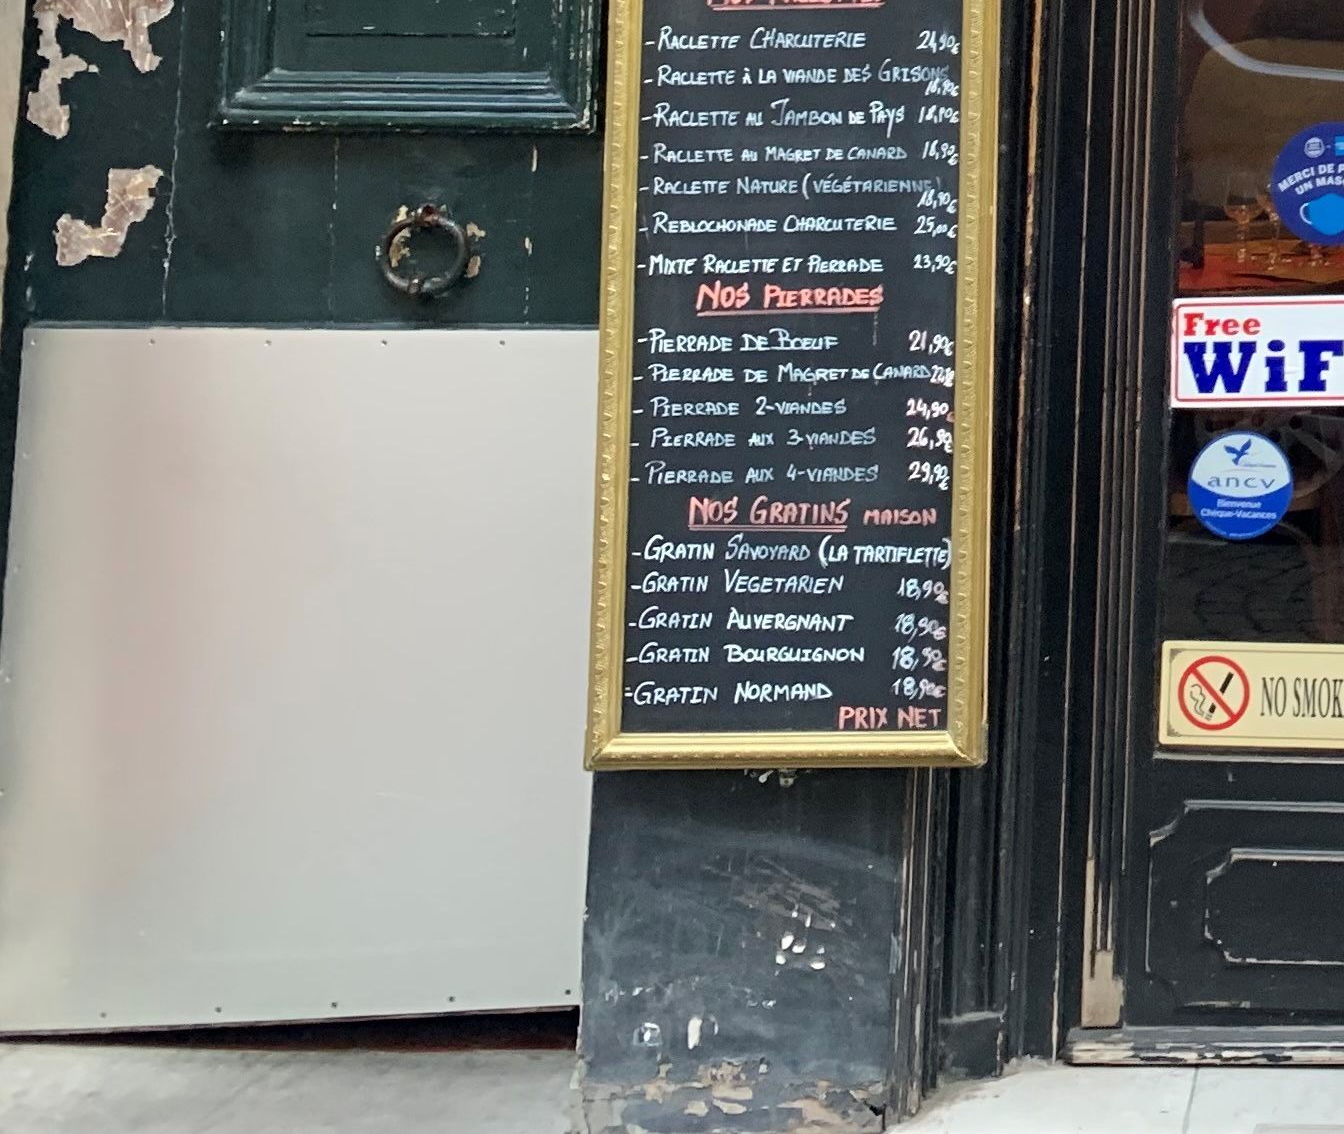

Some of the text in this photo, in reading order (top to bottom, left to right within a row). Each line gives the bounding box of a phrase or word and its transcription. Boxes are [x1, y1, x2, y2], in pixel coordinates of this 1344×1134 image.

[658, 26, 866, 50] RACLETTE CHARCUTERIE
[1278, 167, 1315, 192] MERCI
[1318, 164, 1335, 174] DE
[1295, 181, 1313, 195] UN
[649, 253, 696, 276] MIXTE
[703, 256, 777, 274] RACLETTE
[782, 256, 801, 271] ET
[808, 254, 884, 272] PIERRADE
[696, 280, 884, 310] NOS PIERRADES
[1183, 313, 1261, 336] Free
[648, 328, 733, 354] PIERRADE
[740, 333, 772, 351] DE
[770, 328, 839, 350] BOEUF
[1208, 477, 1275, 488] ancv
[689, 495, 937, 526] NOS GRATINS MAISON
[644, 534, 715, 563] GRATIN
[725, 533, 810, 561] SAVOYARD
[642, 571, 708, 593] GRATIN
[724, 569, 844, 592] VEGETARIEN
[634, 681, 833, 706] GRATIN NORMAND
[1260, 677, 1286, 716] NO
[838, 706, 941, 730] PRIX NET
